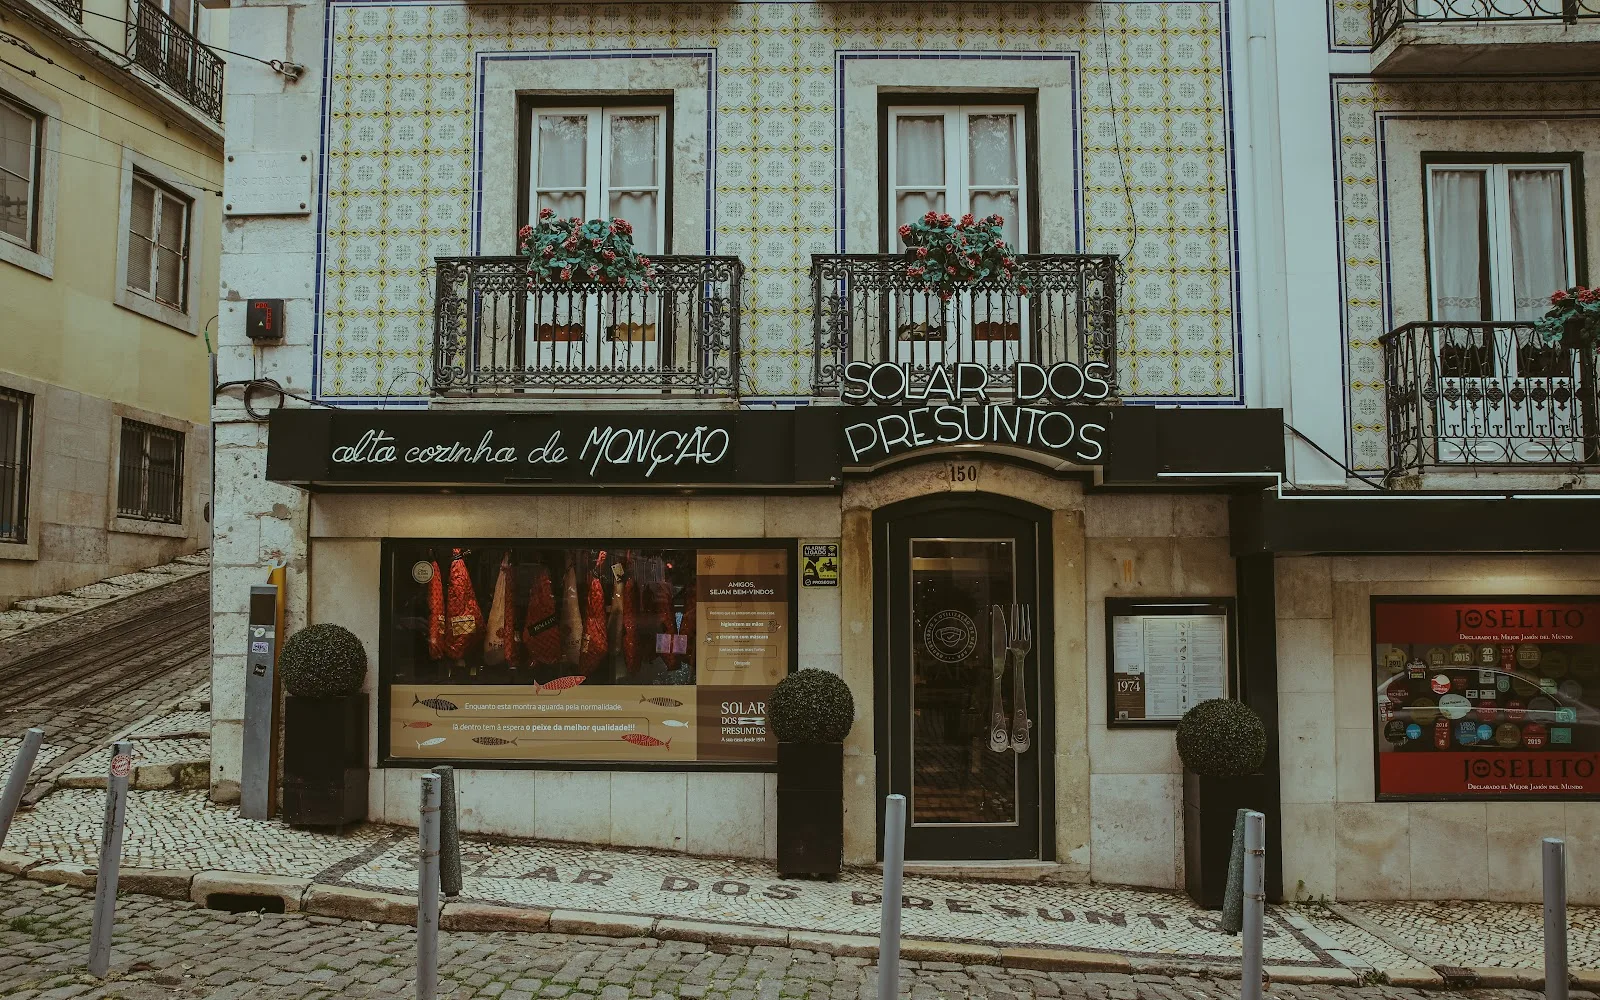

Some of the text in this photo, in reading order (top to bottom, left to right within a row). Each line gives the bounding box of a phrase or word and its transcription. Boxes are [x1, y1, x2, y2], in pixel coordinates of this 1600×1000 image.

[258, 160, 278, 168] RUA
[228, 176, 307, 186] DAS PORTAS DE
[231, 194, 264, 204] SANTO
[844, 361, 1110, 400] SOLAR DOS
[844, 404, 1106, 462] PRESUNTOS
[331, 426, 730, 478] alta cozinha de MONÇÃO
[950, 465, 978, 482] 150
[1456, 609, 1584, 632] JOSELITO
[1454, 653, 1470, 661] 2015
[1117, 681, 1141, 692] 1974
[464, 703, 496, 711] Enquanto
[721, 702, 766, 715] SOLAR
[592, 724, 635, 732] qualidade!!!
[1464, 759, 1594, 782] JOSELITO
[660, 876, 801, 900] DOS
